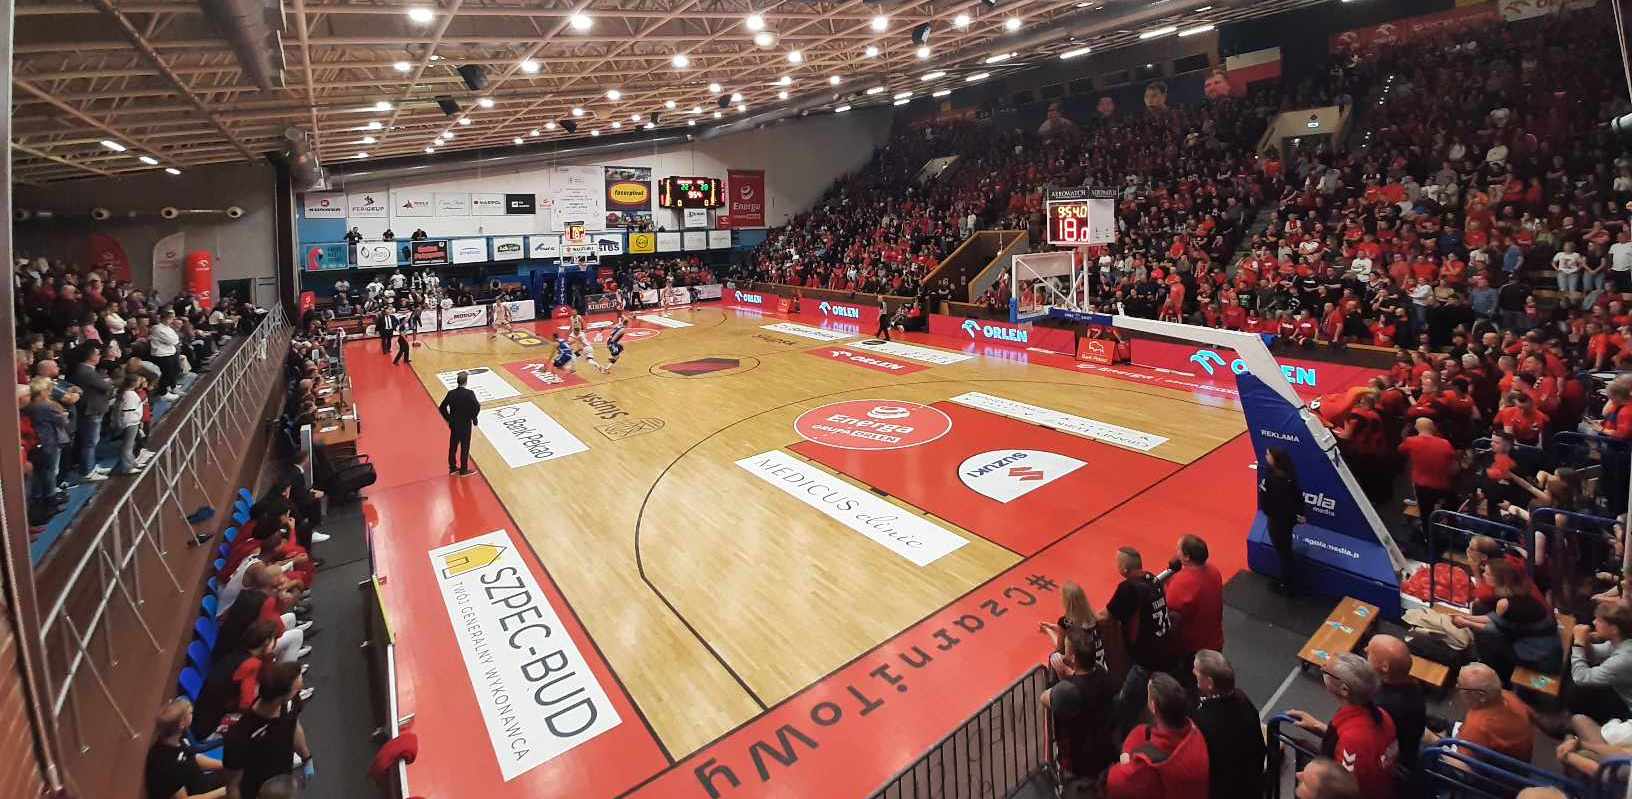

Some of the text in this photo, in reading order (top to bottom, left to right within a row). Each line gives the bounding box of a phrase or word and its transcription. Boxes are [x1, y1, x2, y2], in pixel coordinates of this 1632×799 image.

[743, 293, 762, 304] ORLEN
[832, 305, 859, 318] ORLEN
[982, 325, 1028, 343] ORLEN
[1230, 358, 1316, 387] OEN
[811, 424, 897, 443] GRUPA ORLEN
[826, 414, 914, 434] Energa
[1261, 429, 1300, 443] REKLAMA
[503, 418, 554, 460] Bank Pekao
[967, 451, 1028, 478] SUZUKI
[755, 457, 925, 551] MEDICUS clinic
[480, 566, 598, 738] SZPEC-BUD
[462, 604, 493, 666] GENERALNY
[485, 668, 531, 761] WYKONAWCA
[693, 573, 1059, 799] #CzarniToMy
